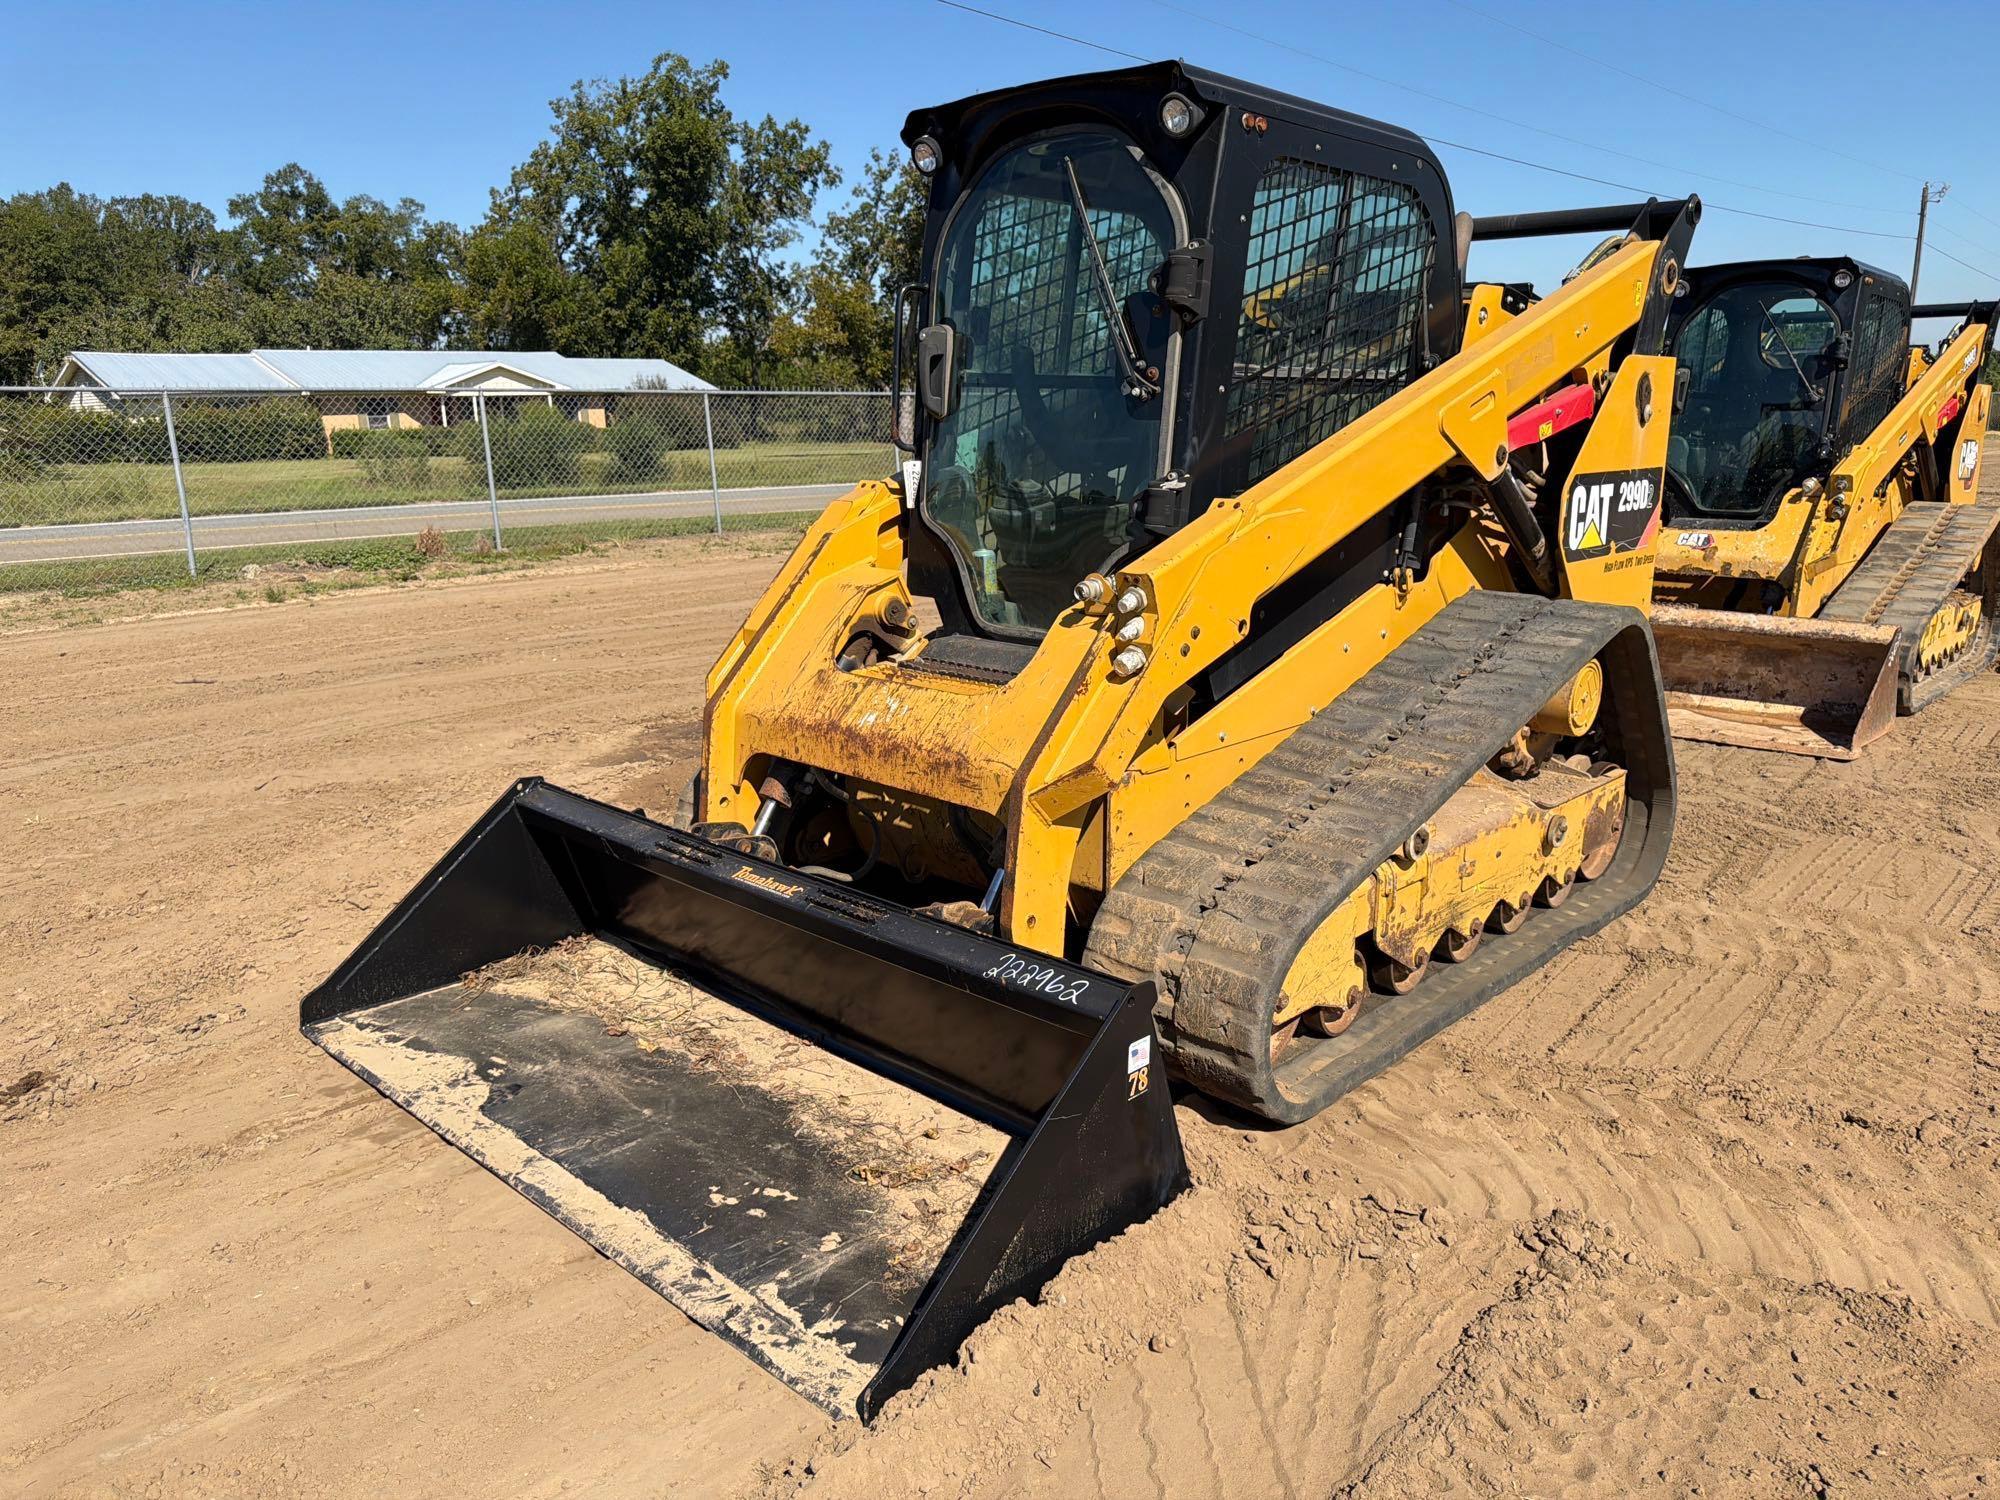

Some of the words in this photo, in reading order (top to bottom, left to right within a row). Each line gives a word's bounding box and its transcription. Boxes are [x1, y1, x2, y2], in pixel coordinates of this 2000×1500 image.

[1569, 483, 1614, 551] CAT
[1677, 532, 1709, 547] CAT
[731, 865, 804, 897] Tomahawk
[982, 953, 1090, 1005] 222962
[1128, 1066, 1149, 1097] 78
